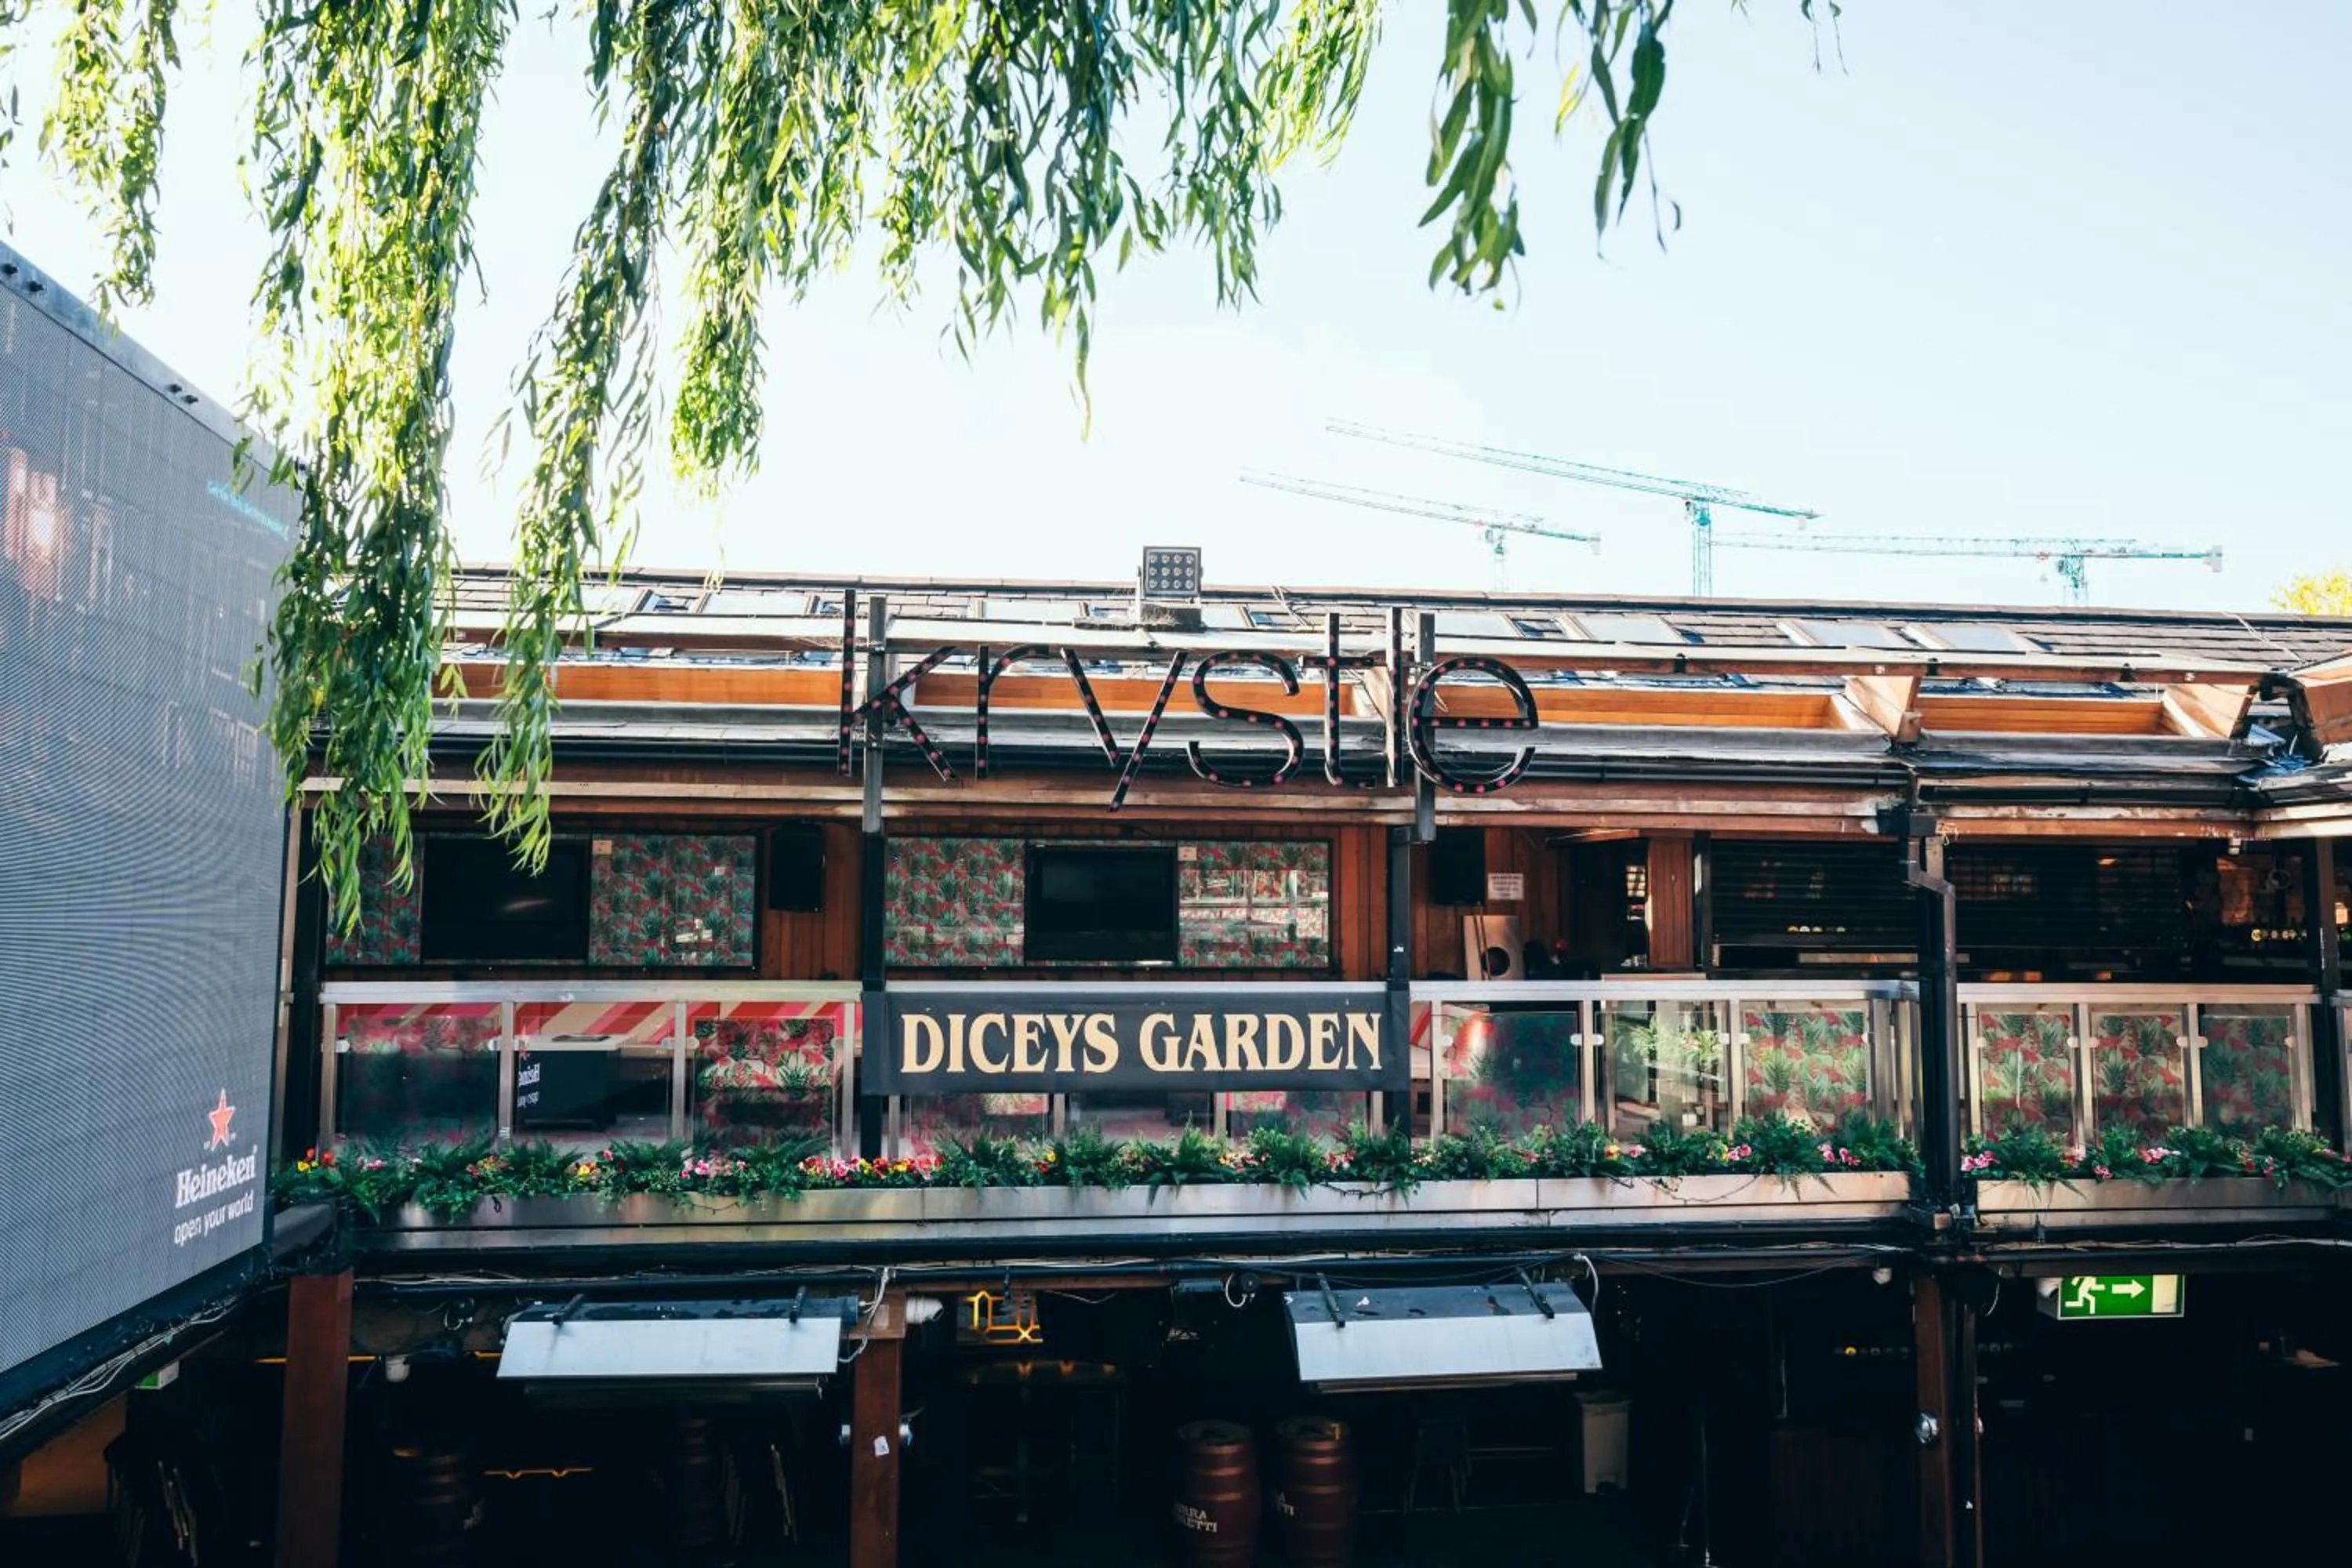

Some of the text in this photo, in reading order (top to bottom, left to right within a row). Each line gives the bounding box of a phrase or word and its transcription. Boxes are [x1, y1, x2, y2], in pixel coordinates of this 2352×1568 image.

[836, 589, 1538, 813] krystle
[900, 1012, 1383, 1073] DICEYS GARDEN
[175, 1153, 256, 1209] Heineken
[174, 1189, 254, 1247] open your world
